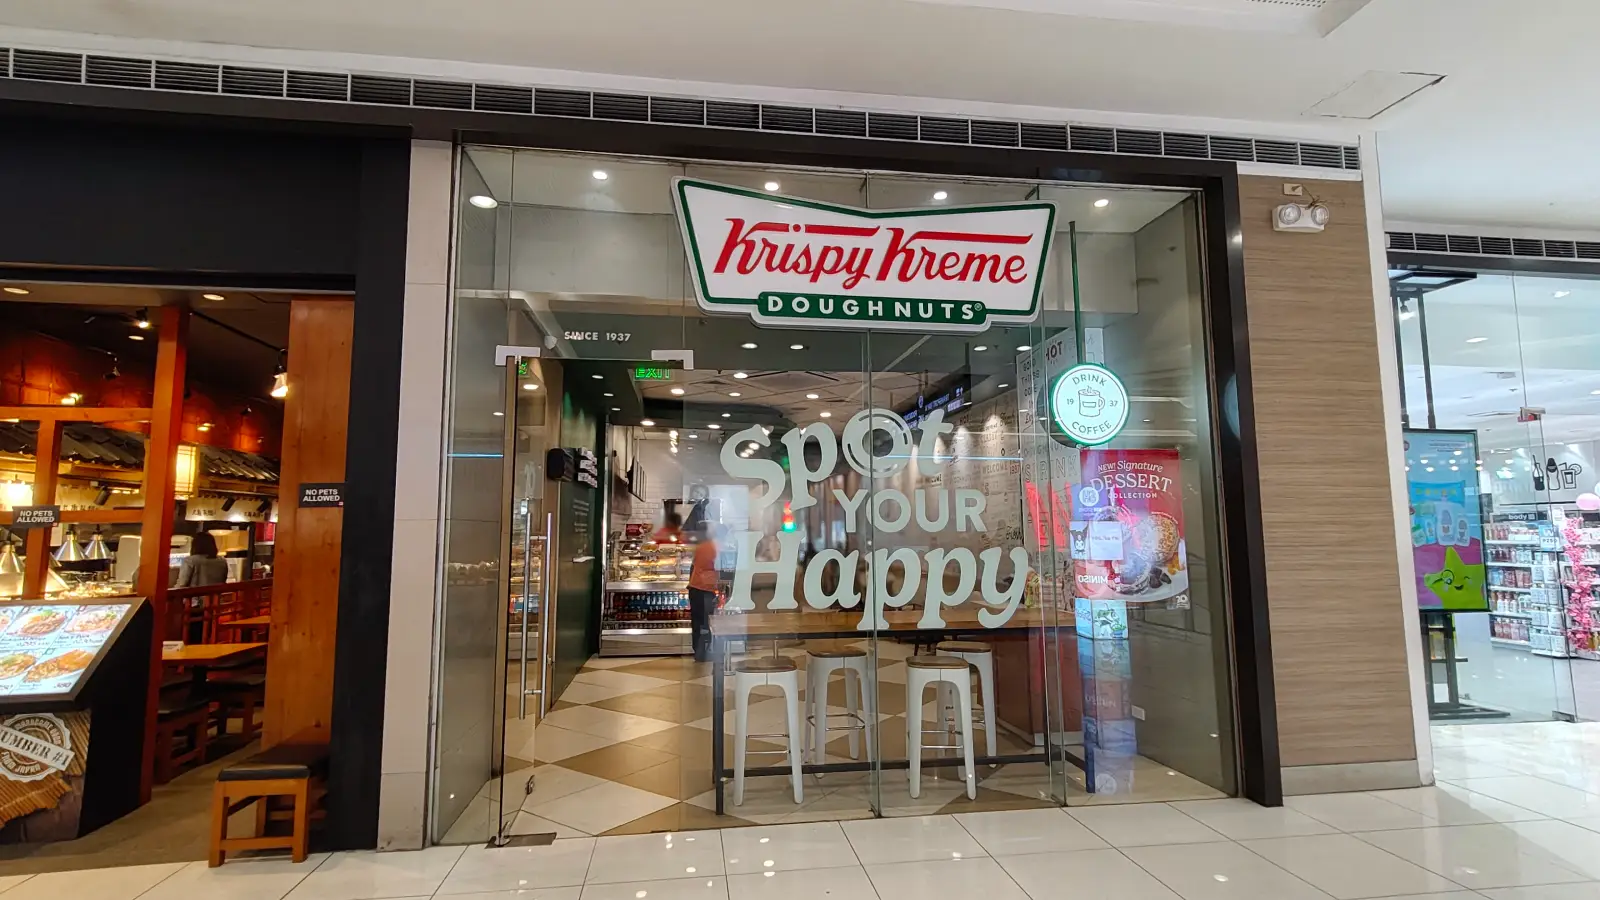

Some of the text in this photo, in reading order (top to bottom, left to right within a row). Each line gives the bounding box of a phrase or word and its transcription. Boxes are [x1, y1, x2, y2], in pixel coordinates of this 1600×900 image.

[712, 217, 1034, 290] Krispy Kreme
[564, 331, 632, 342] SINCE 1937
[635, 366, 671, 380] EXIT
[1072, 373, 1107, 387] DRINK
[1066, 398, 1075, 406] 19
[1071, 420, 1112, 435] COFFEE
[720, 408, 954, 511] Spot
[1097, 460, 1164, 473] NEW! Signature
[1090, 473, 1173, 493] DESSERT
[832, 489, 987, 533] YOUR
[724, 531, 1029, 631] Happy
[52, 751, 70, 767] #1
